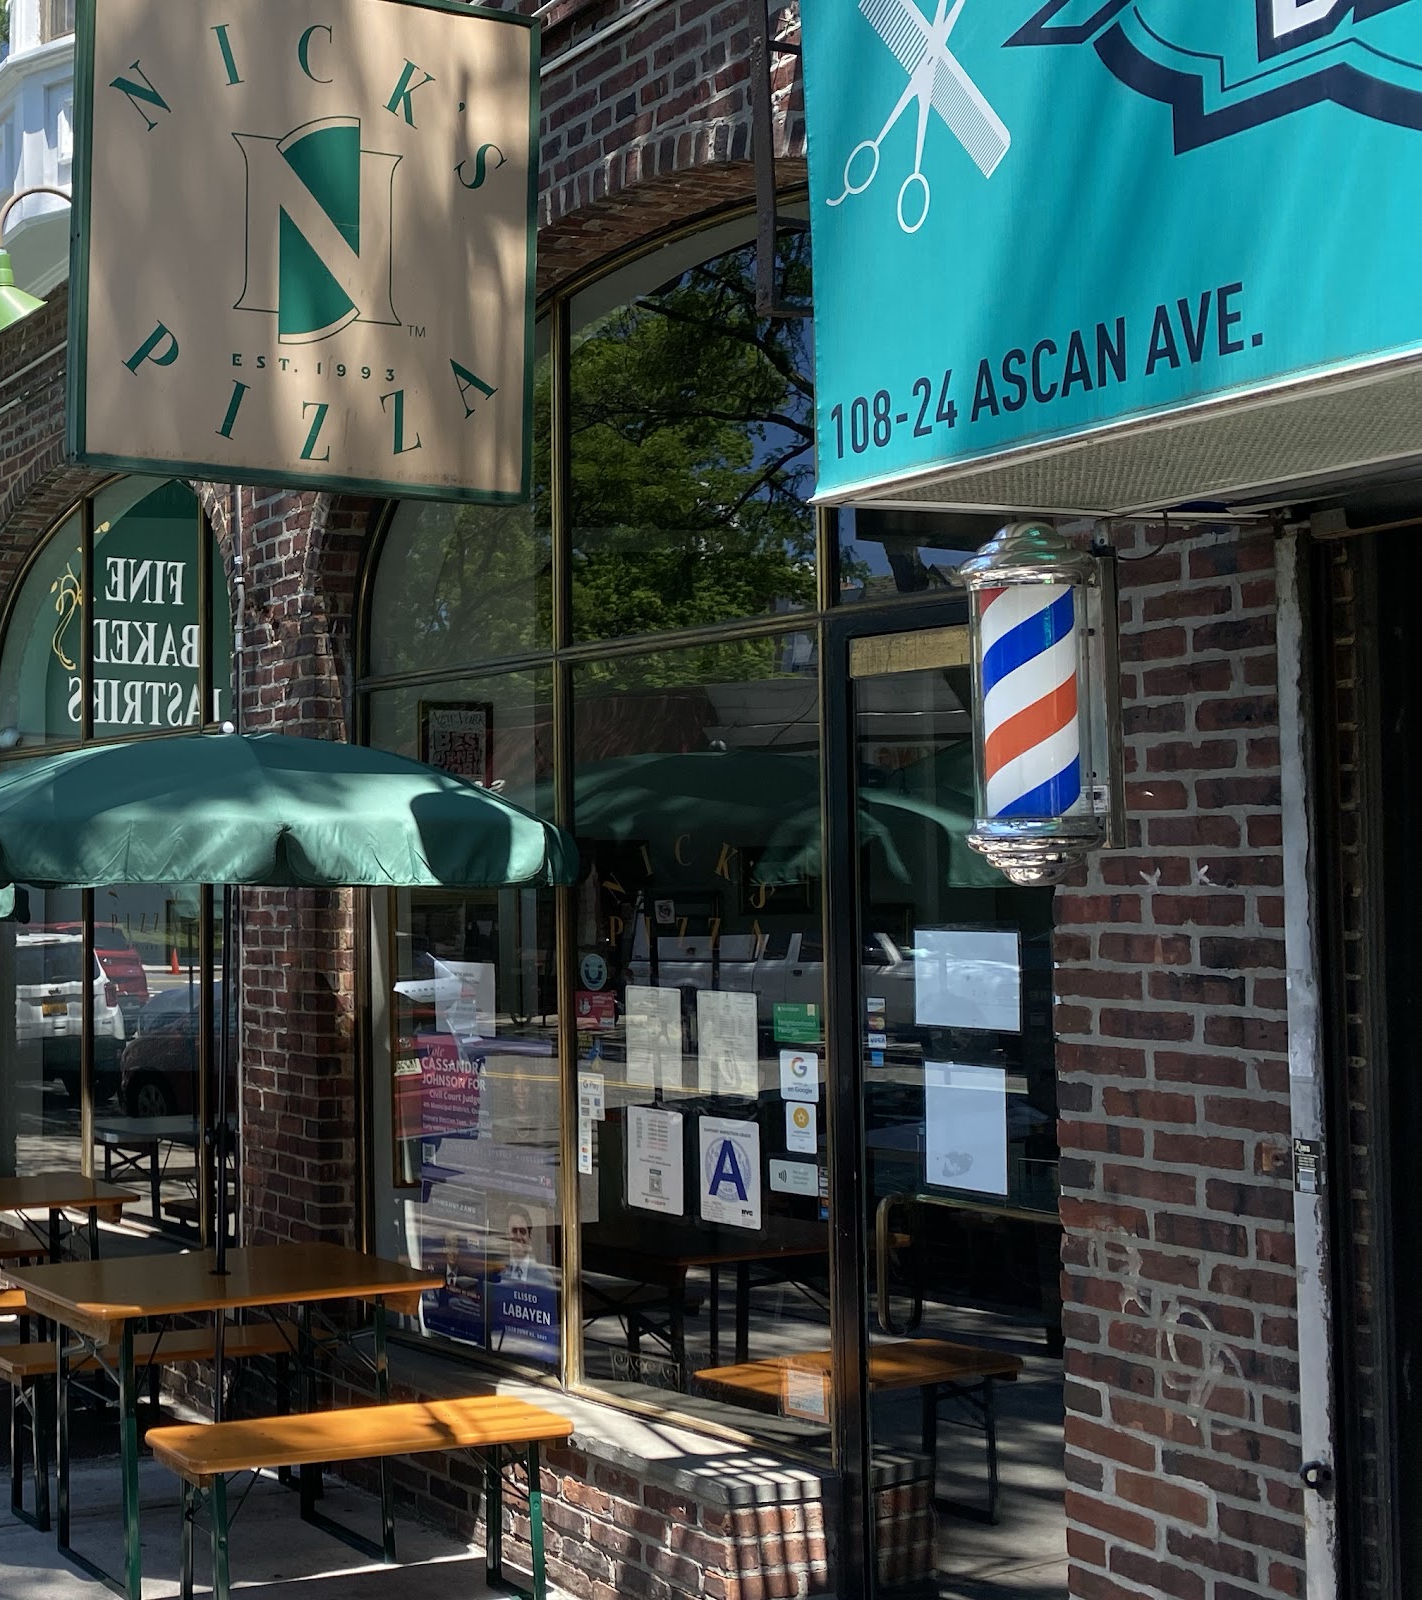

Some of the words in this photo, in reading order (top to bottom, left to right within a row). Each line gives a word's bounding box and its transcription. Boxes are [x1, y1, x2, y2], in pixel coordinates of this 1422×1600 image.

[109, 24, 507, 189] NICK'S
[408, 326, 426, 338] TM
[232, 353, 298, 373] EST.
[316, 362, 395, 381] 1993
[831, 369, 958, 459] 108-24
[971, 317, 1127, 423] ASCAN
[1145, 281, 1264, 376] AVE.
[122, 320, 498, 462] PIZZA
[422, 1057, 487, 1077] CASSANDRA
[422, 1073, 467, 1089] JOHNSON
[468, 1079, 486, 1091] FOR
[429, 1090, 443, 1100] Civil
[444, 1091, 461, 1102] Court
[709, 1139, 748, 1202] A
[513, 1290, 538, 1304] ELISEO
[503, 1301, 551, 1326] LABAYEN
